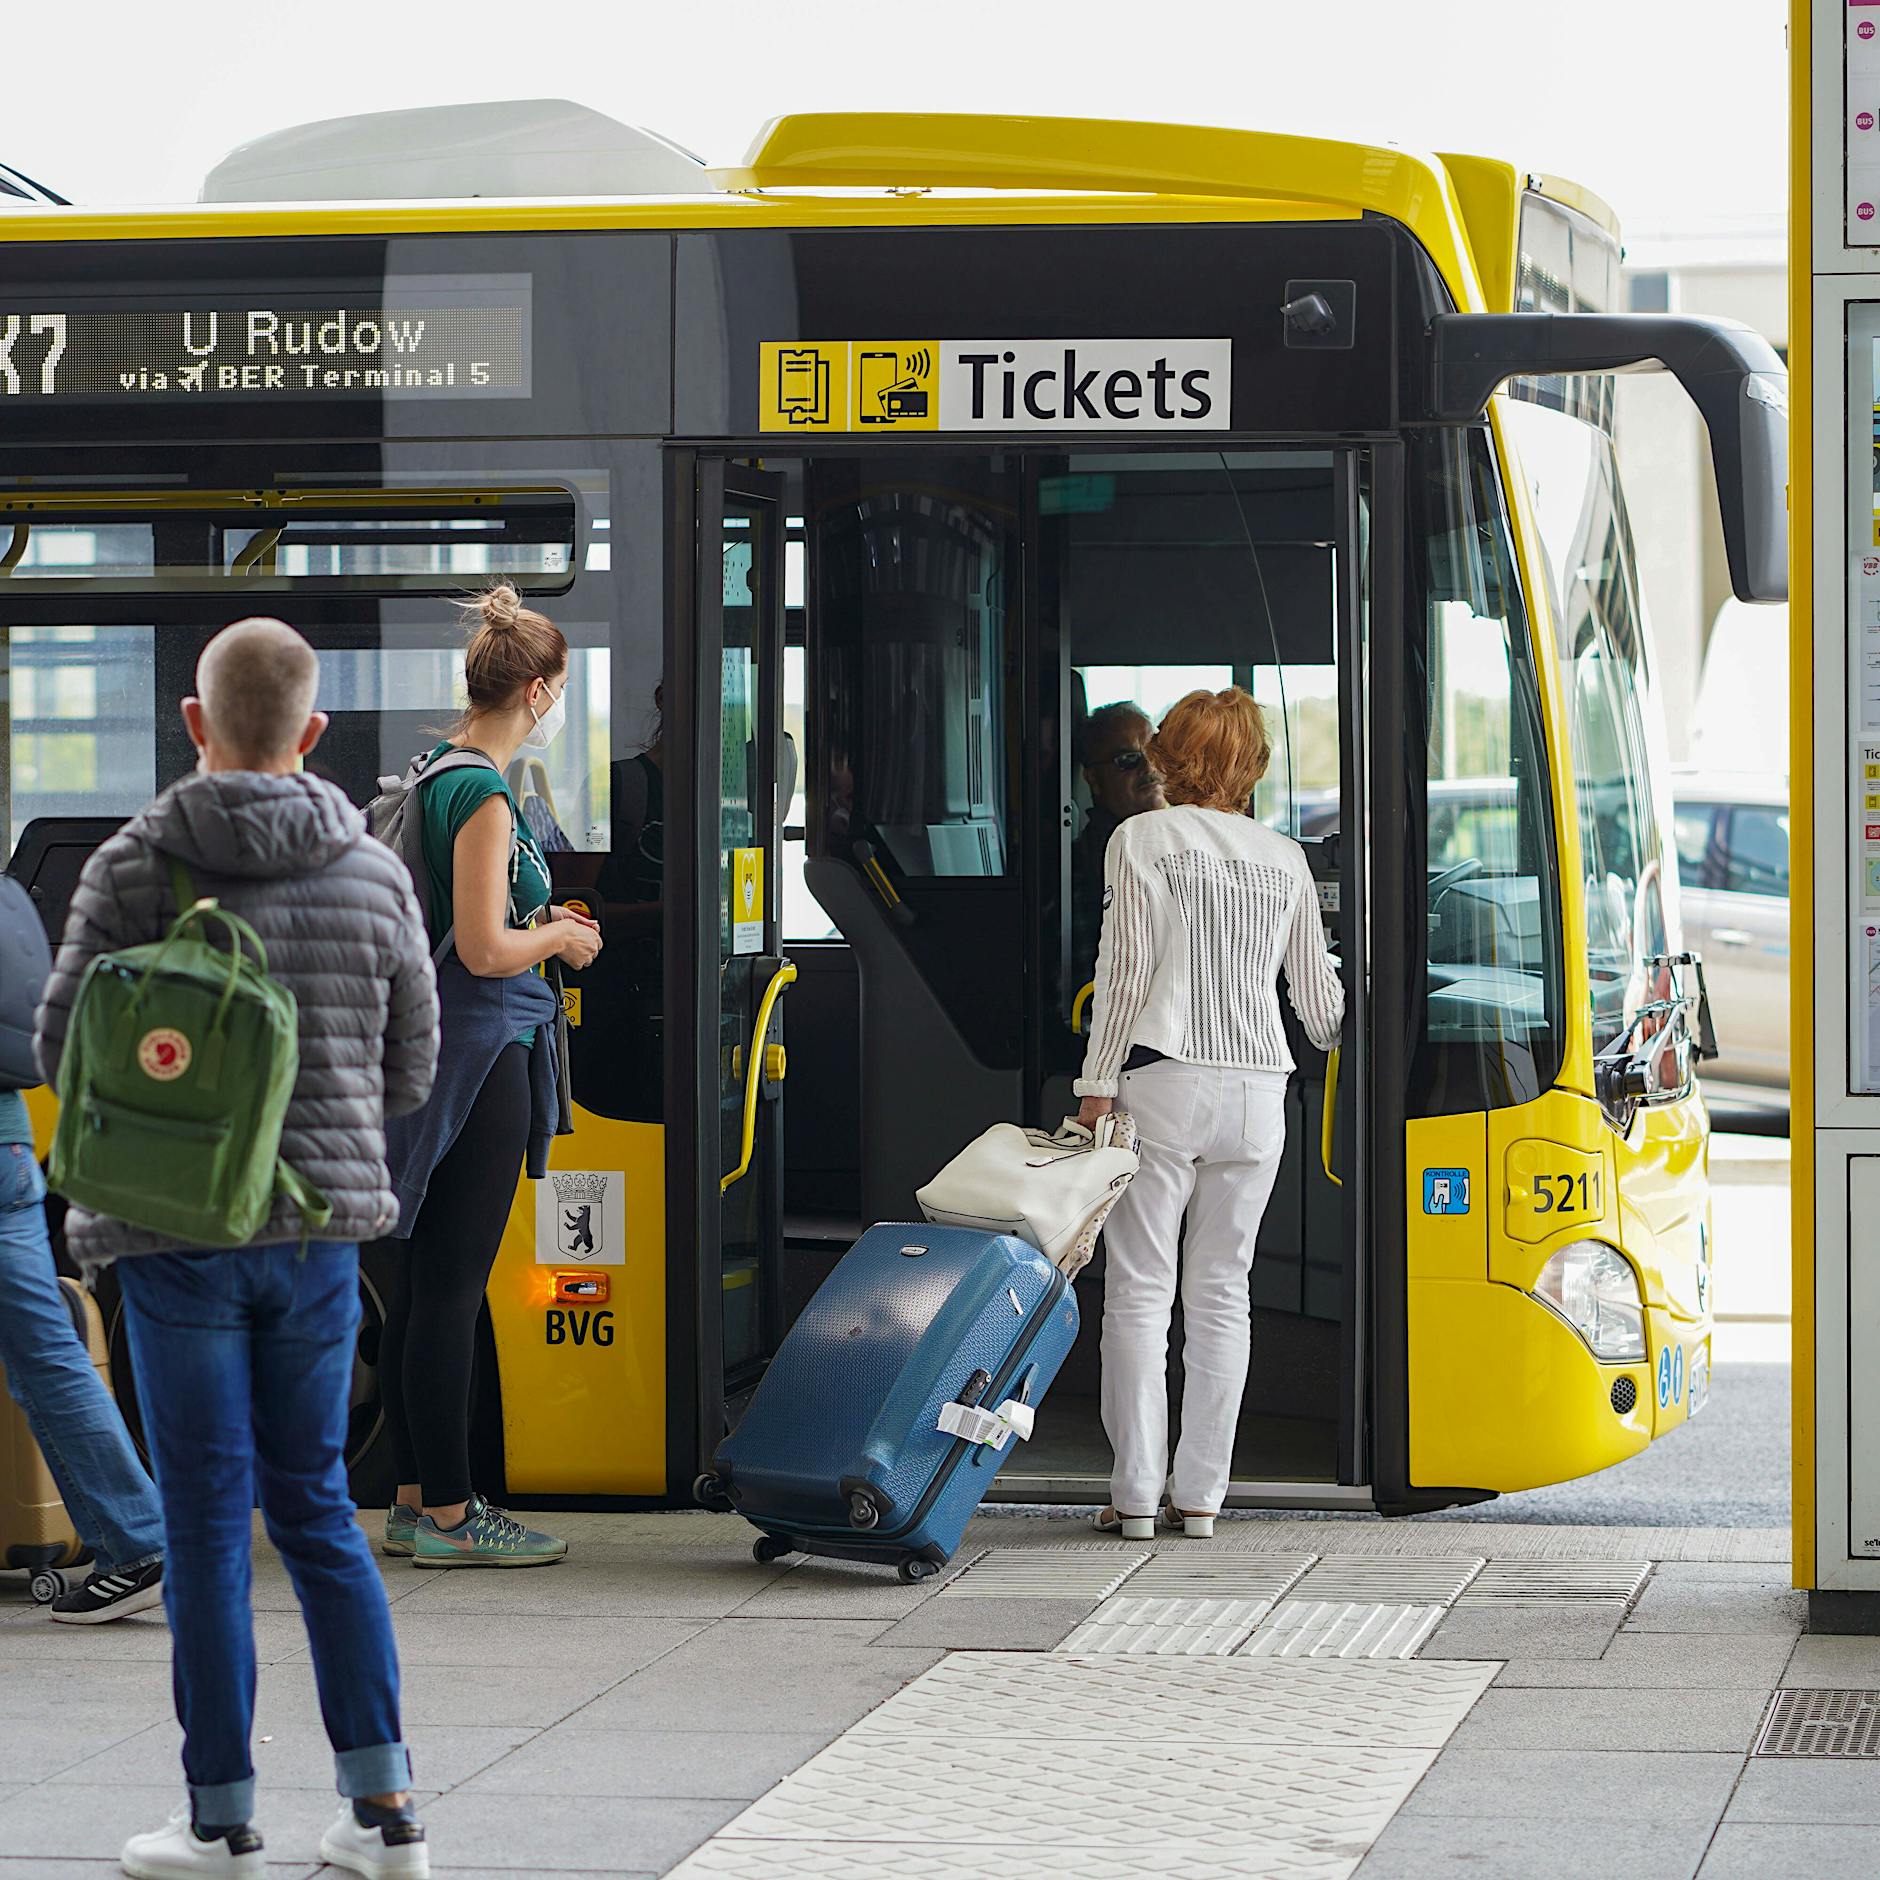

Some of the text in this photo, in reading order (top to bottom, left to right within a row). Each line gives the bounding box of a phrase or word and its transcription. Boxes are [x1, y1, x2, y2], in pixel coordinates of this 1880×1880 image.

[1858, 26, 1875, 35] BUS
[1857, 117, 1873, 126] BUS
[1858, 207, 1874, 216] BUS
[183, 309, 425, 355] U Rudow
[120, 362, 490, 391] via BER Terminal 5
[958, 349, 1212, 420] Tickets
[1534, 1172, 1600, 1213] 5211
[546, 1310, 614, 1346] BVG
